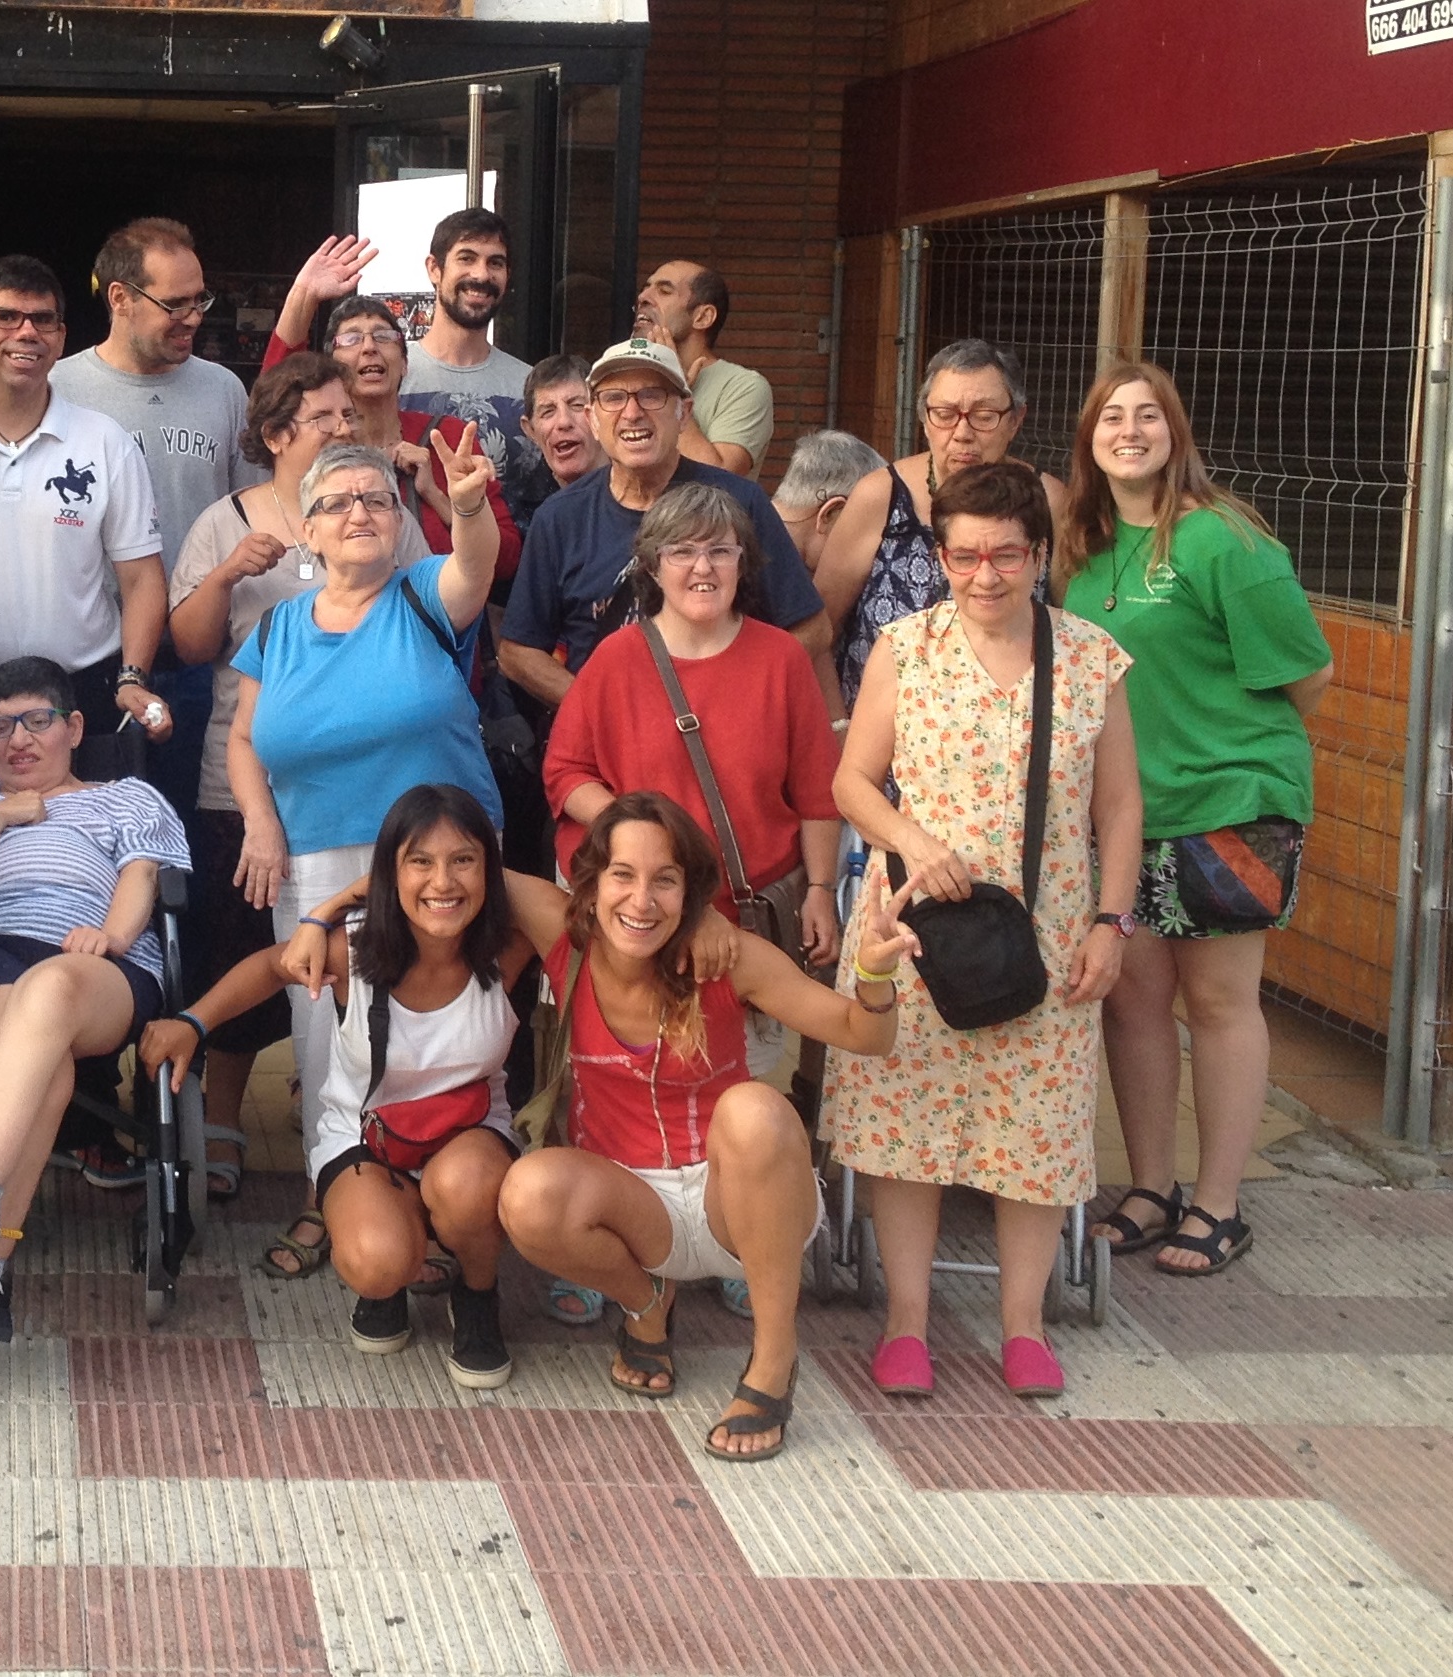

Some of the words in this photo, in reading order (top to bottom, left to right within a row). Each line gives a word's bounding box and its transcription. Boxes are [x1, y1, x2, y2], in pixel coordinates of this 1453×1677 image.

[1372, 12, 1398, 42] 666
[1401, 5, 1427, 35] 404
[159, 426, 220, 466] YORK
